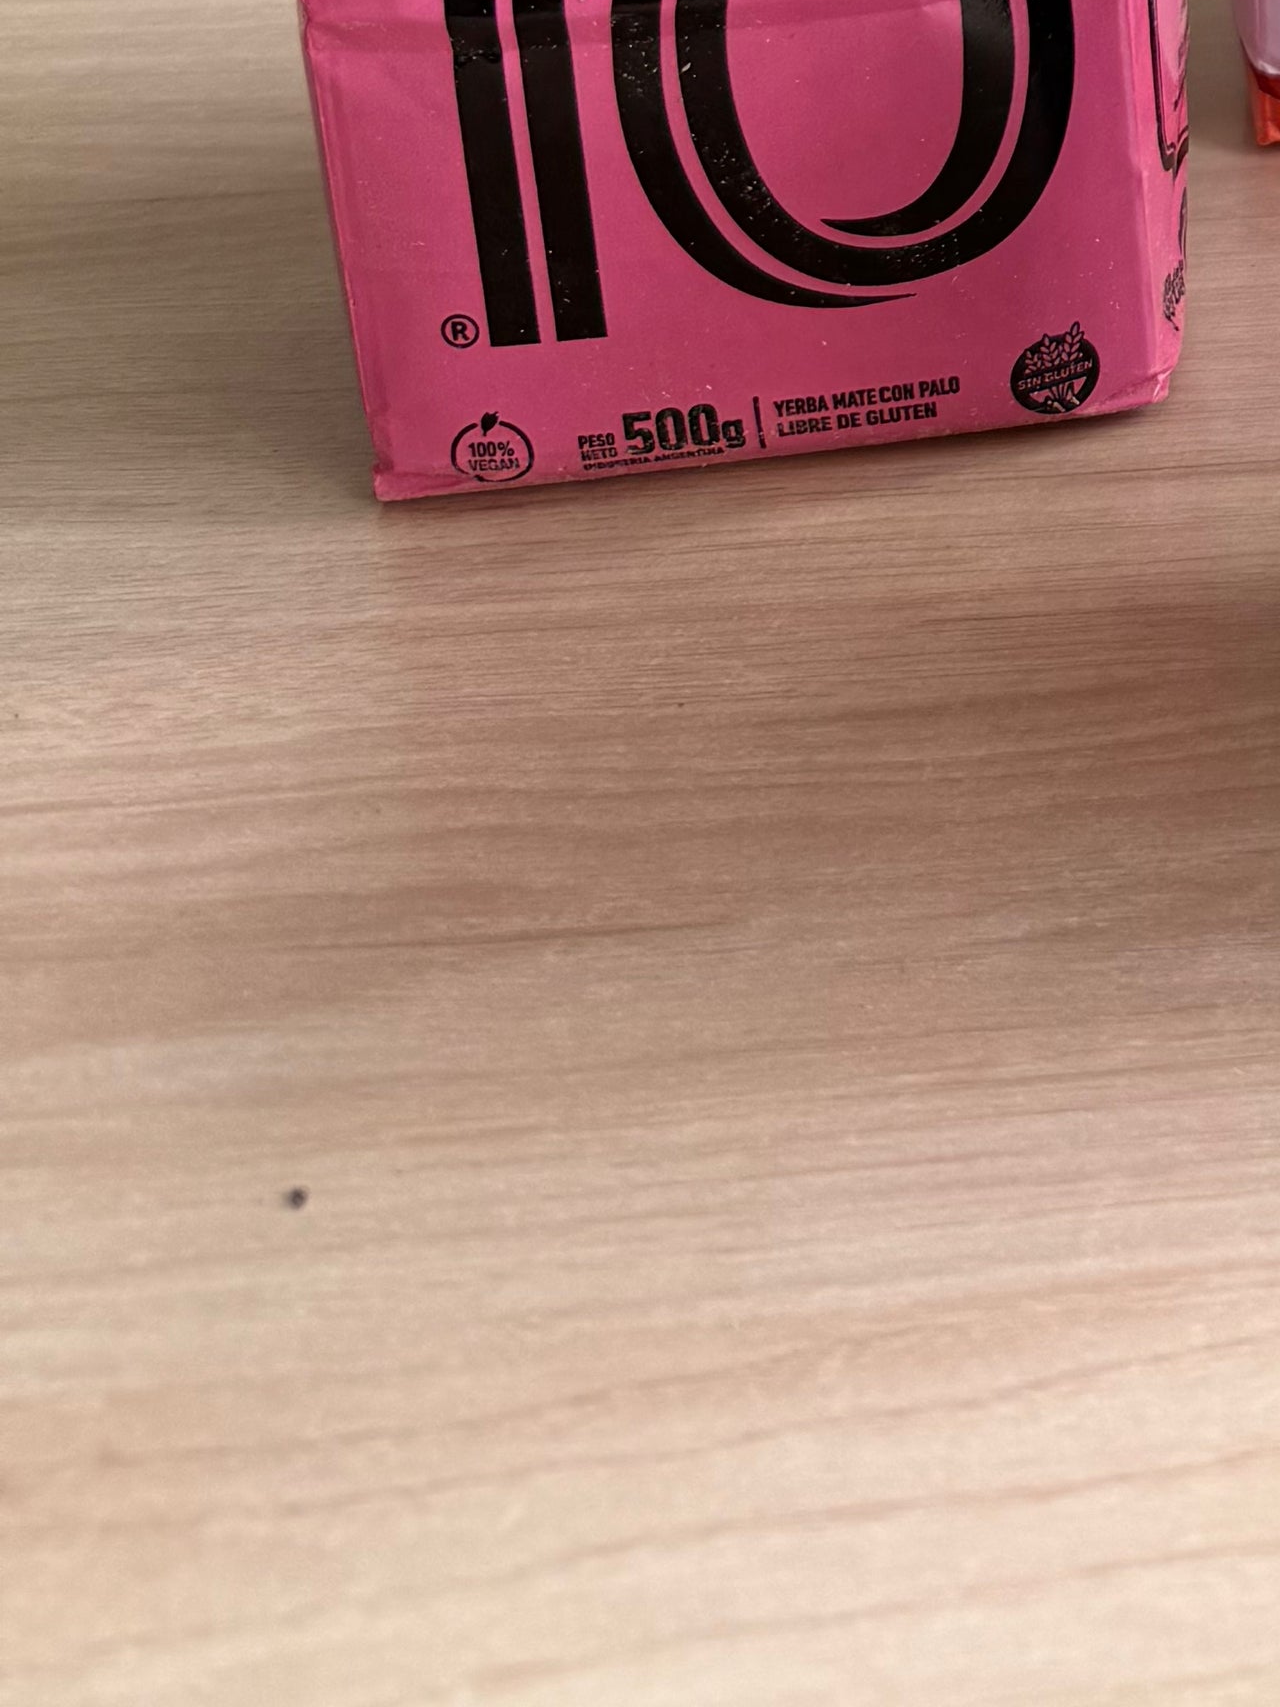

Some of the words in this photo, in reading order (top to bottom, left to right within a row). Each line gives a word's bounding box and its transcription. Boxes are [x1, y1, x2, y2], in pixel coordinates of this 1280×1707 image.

[1017, 375, 1042, 391] SIN
[1044, 358, 1094, 382] GLUTEN
[773, 397, 829, 418] YERBA
[833, 389, 877, 411] MATE
[879, 383, 914, 404] CON
[918, 376, 961, 398] PALO
[622, 403, 746, 455] 500g
[776, 416, 833, 438] LIBRE
[837, 411, 862, 430] DE
[866, 401, 938, 427] GLUTEN
[468, 441, 515, 458] 100%
[577, 432, 615, 450] PESO
[468, 458, 520, 472] VEGAN
[580, 447, 618, 462] NETO
